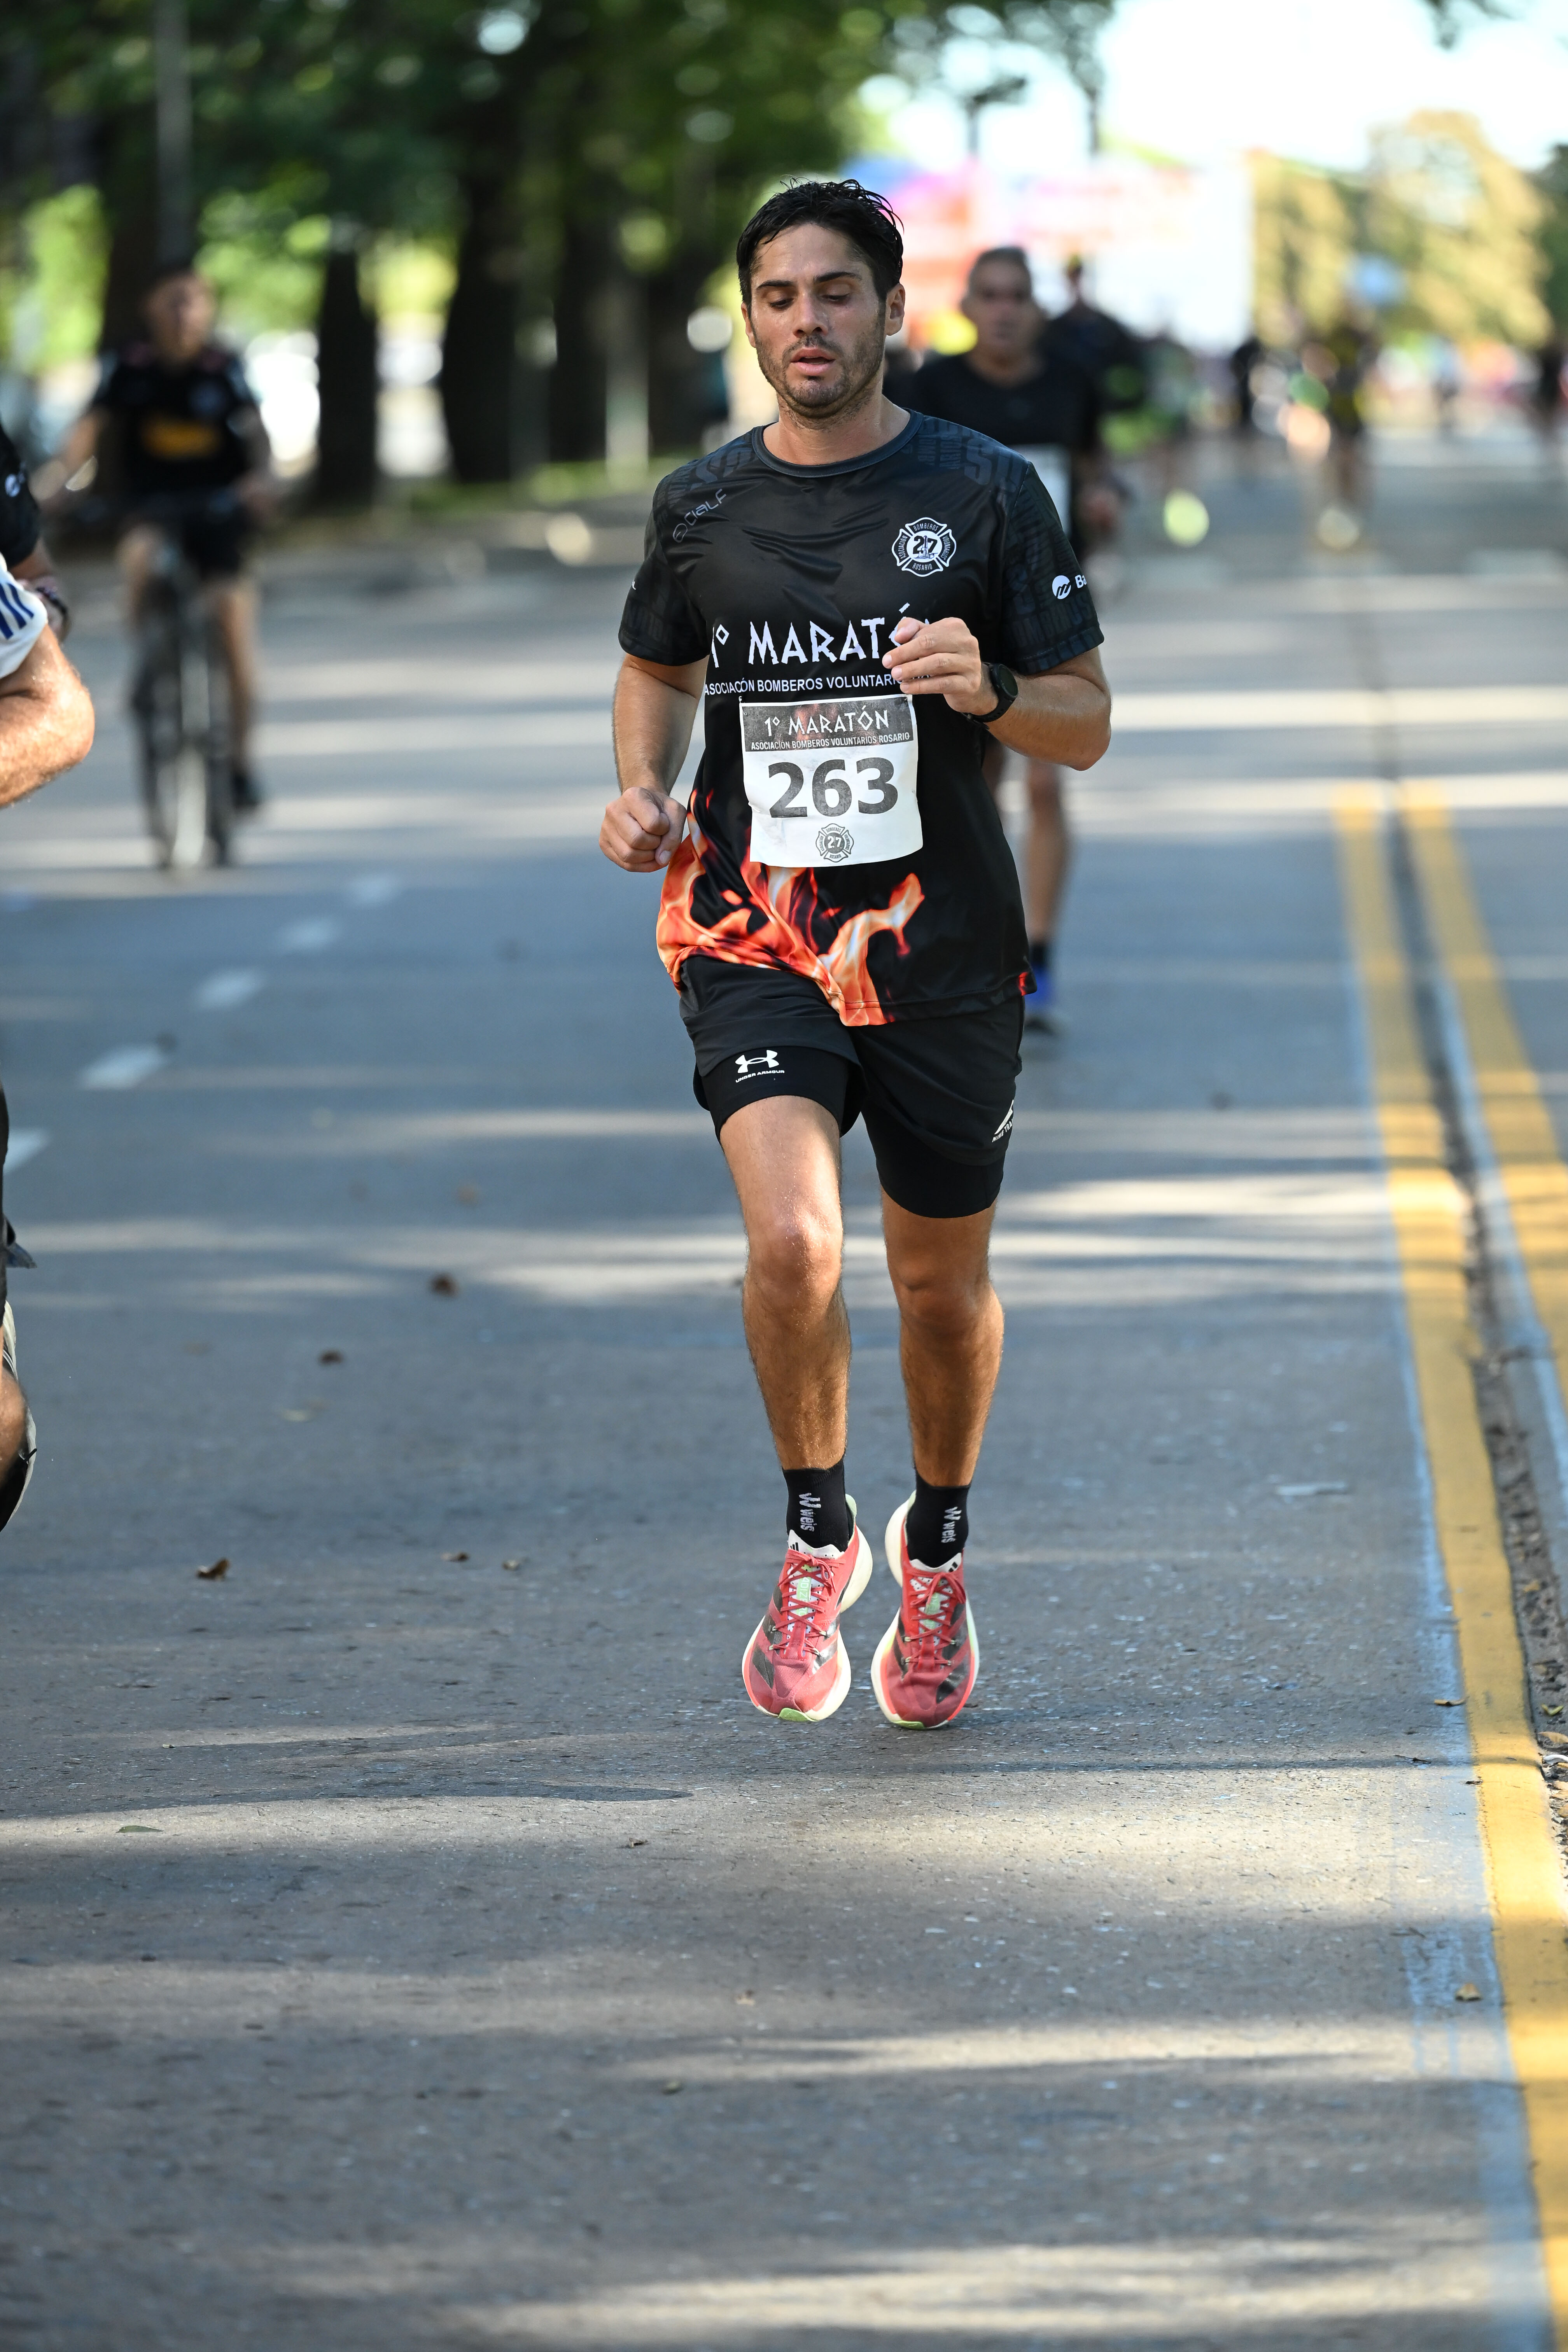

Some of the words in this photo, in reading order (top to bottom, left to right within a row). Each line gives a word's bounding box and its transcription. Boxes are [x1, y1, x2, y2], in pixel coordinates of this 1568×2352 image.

[914, 523, 939, 531] BOMBEROS
[913, 536, 938, 555] 27
[757, 678, 823, 692] BOMBEROS
[788, 705, 889, 735] MARATÓN
[792, 738, 830, 748] BOMBEROS
[831, 737, 877, 746] VOLUNTARIOS
[879, 732, 910, 743] ROSARIO
[768, 757, 898, 818] 263
[827, 836, 842, 849] 27
[735, 1073, 756, 1083] UNDER
[992, 1130, 1004, 1143] NIKE
